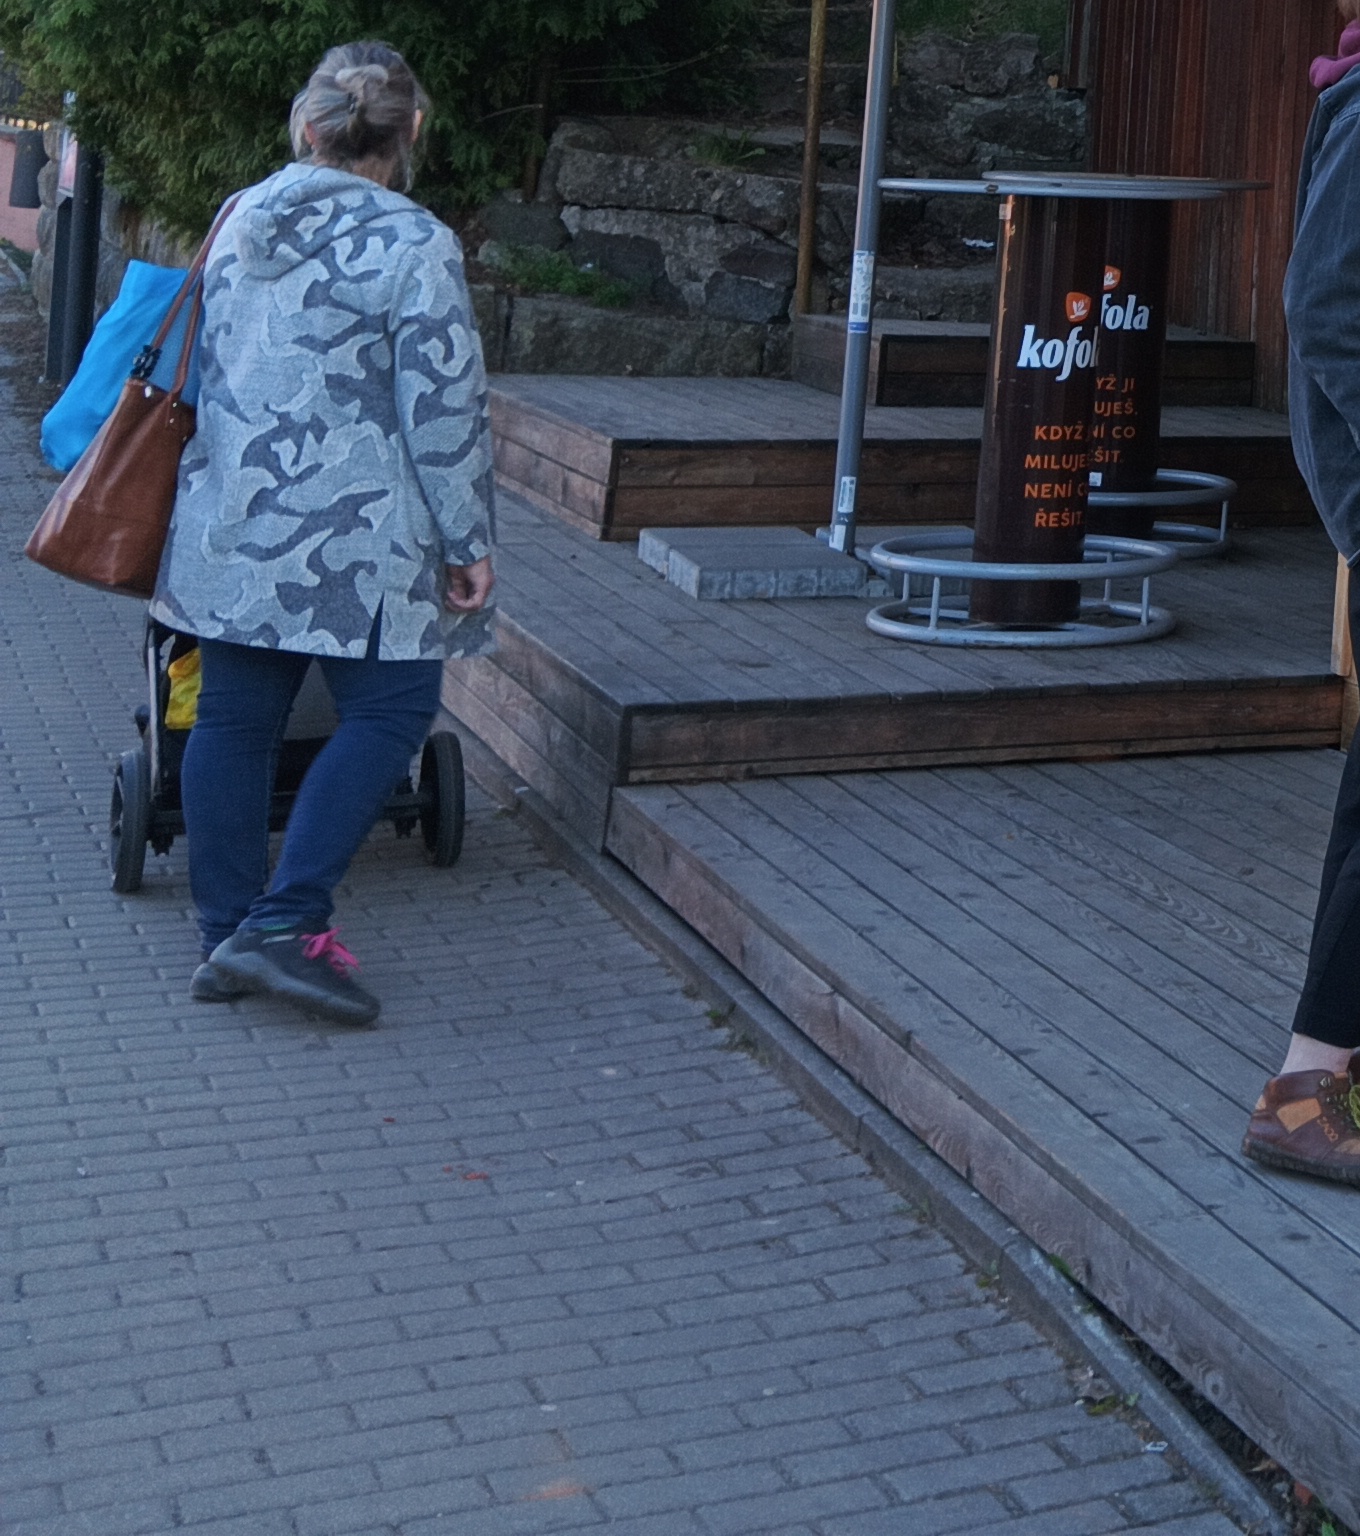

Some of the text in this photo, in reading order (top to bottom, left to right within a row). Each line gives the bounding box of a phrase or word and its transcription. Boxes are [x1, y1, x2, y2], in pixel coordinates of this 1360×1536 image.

[1100, 293, 1150, 331] fola
[1095, 373, 1135, 394] YŽ JI
[1094, 398, 1138, 417] UJEŠ.
[1034, 420, 1083, 441] KDYŽ
[1112, 426, 1136, 440] CO
[1024, 453, 1090, 473] MILUJE
[1024, 479, 1072, 499] NENÍ
